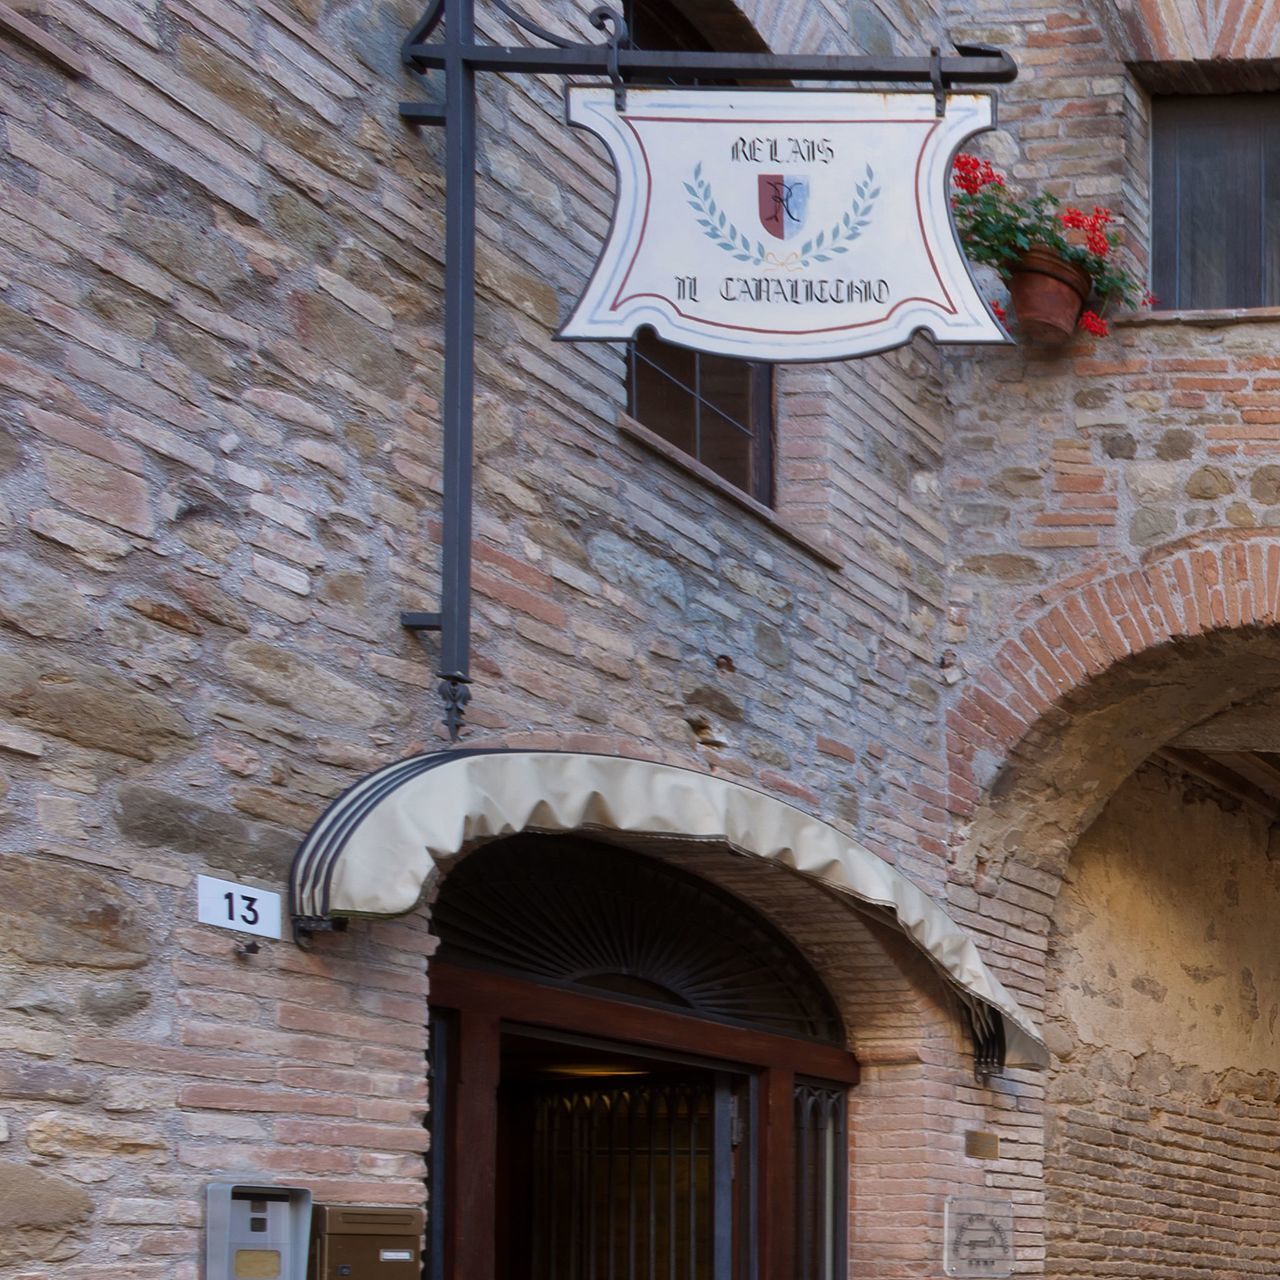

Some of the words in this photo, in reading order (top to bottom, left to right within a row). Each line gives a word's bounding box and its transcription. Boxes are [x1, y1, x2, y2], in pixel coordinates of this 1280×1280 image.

[731, 136, 834, 165] RELAIS
[675, 275, 700, 302] IL
[719, 276, 890, 304] CANALICCHIO
[223, 891, 260, 926] 13
